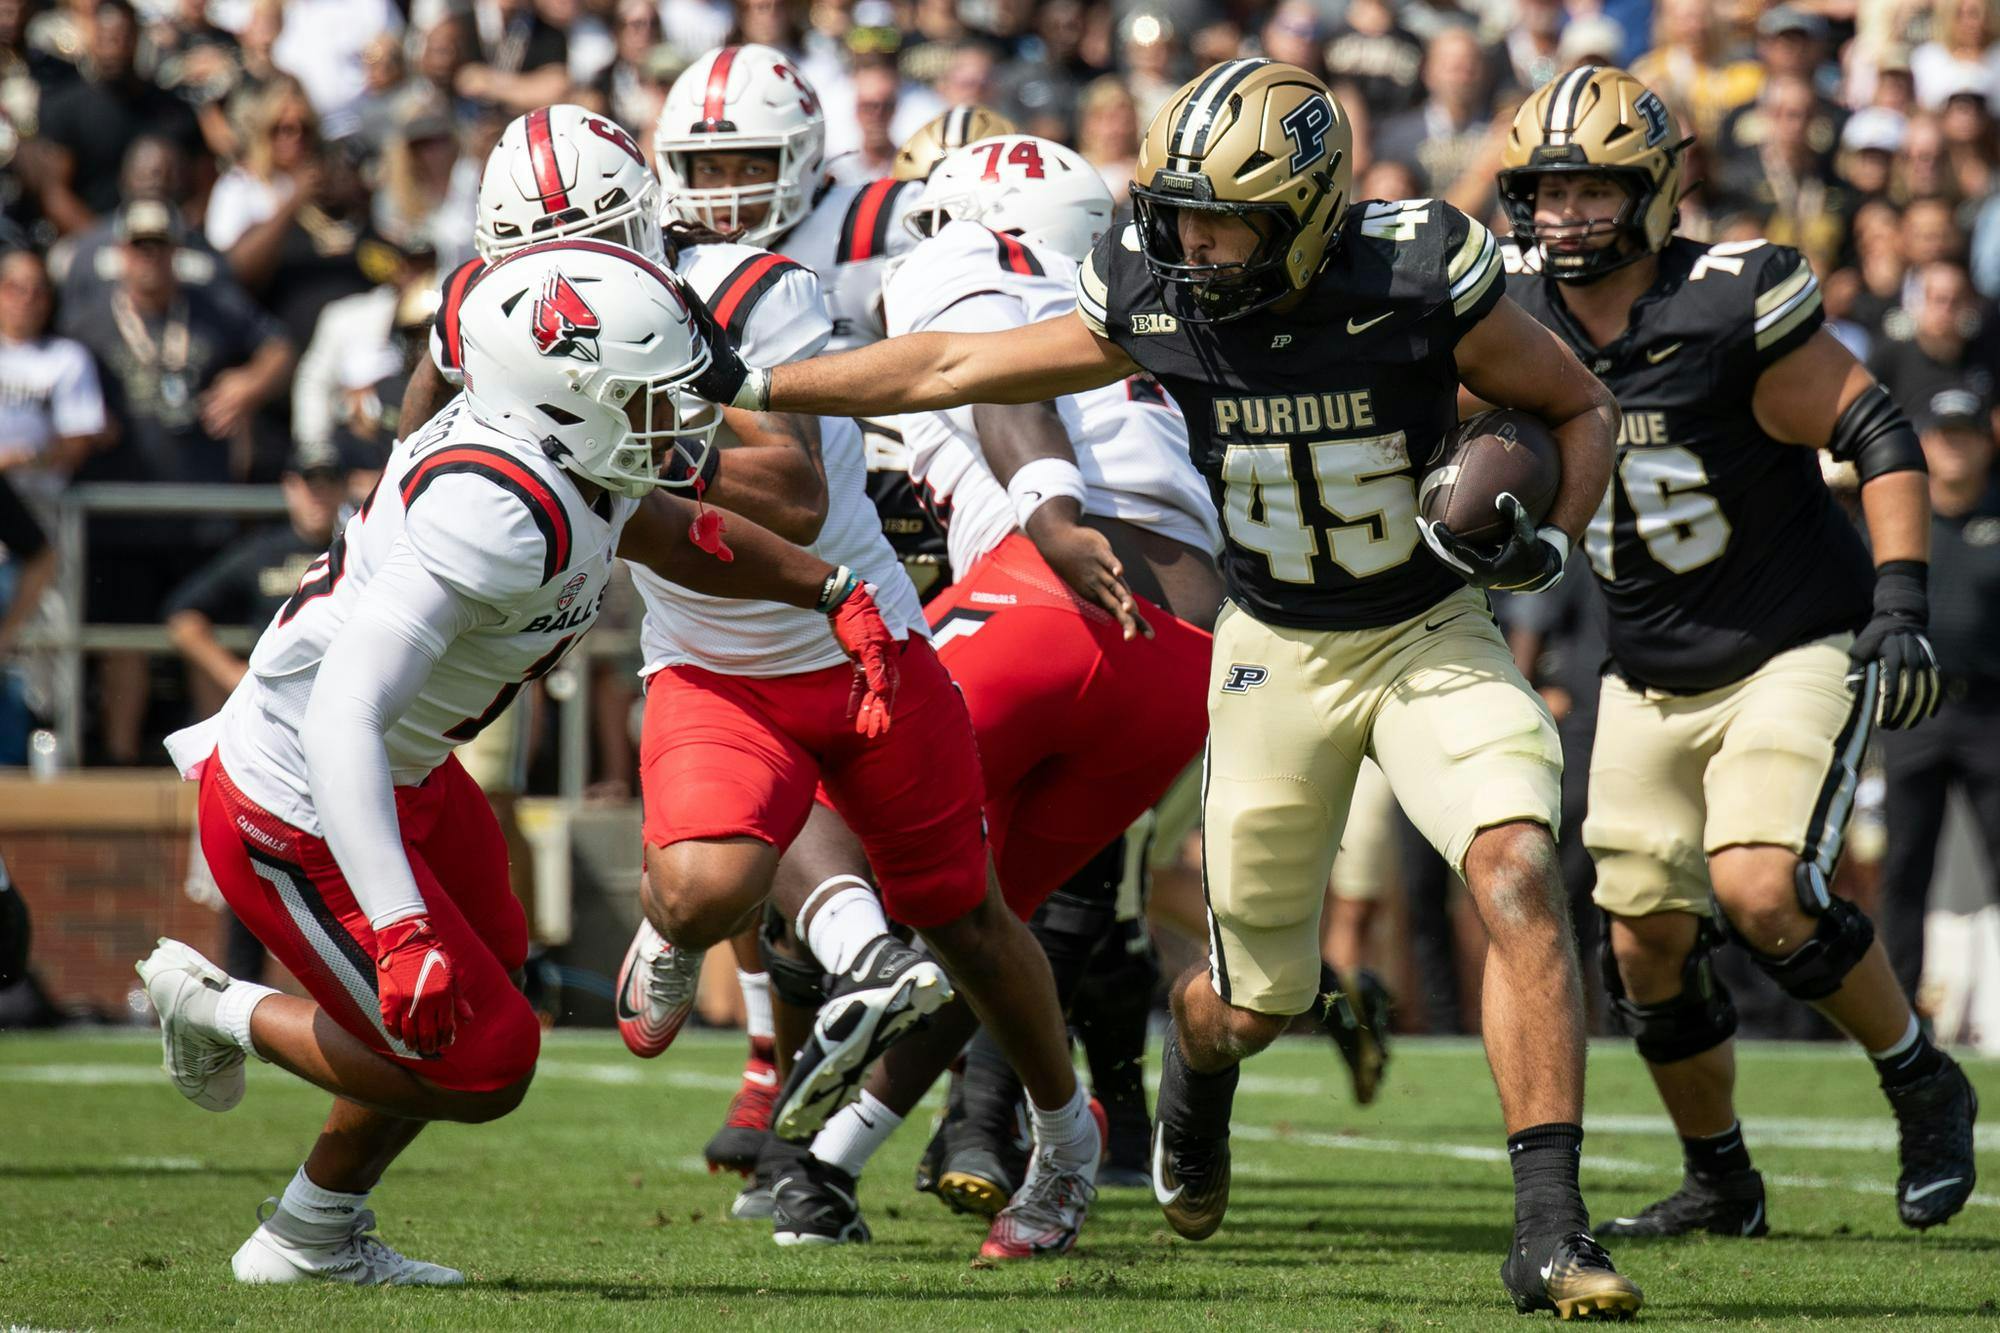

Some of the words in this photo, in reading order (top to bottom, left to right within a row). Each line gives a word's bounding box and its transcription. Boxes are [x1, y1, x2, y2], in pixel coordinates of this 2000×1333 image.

[1280, 93, 1334, 177] P
[971, 141, 1045, 183] 74
[1271, 334, 1292, 349] P
[1212, 388, 1376, 436] PURDUE
[1221, 430, 1423, 584] 45
[519, 598, 594, 634] BALL
[1221, 663, 1270, 695] P
[236, 814, 287, 852] CARDINALS
